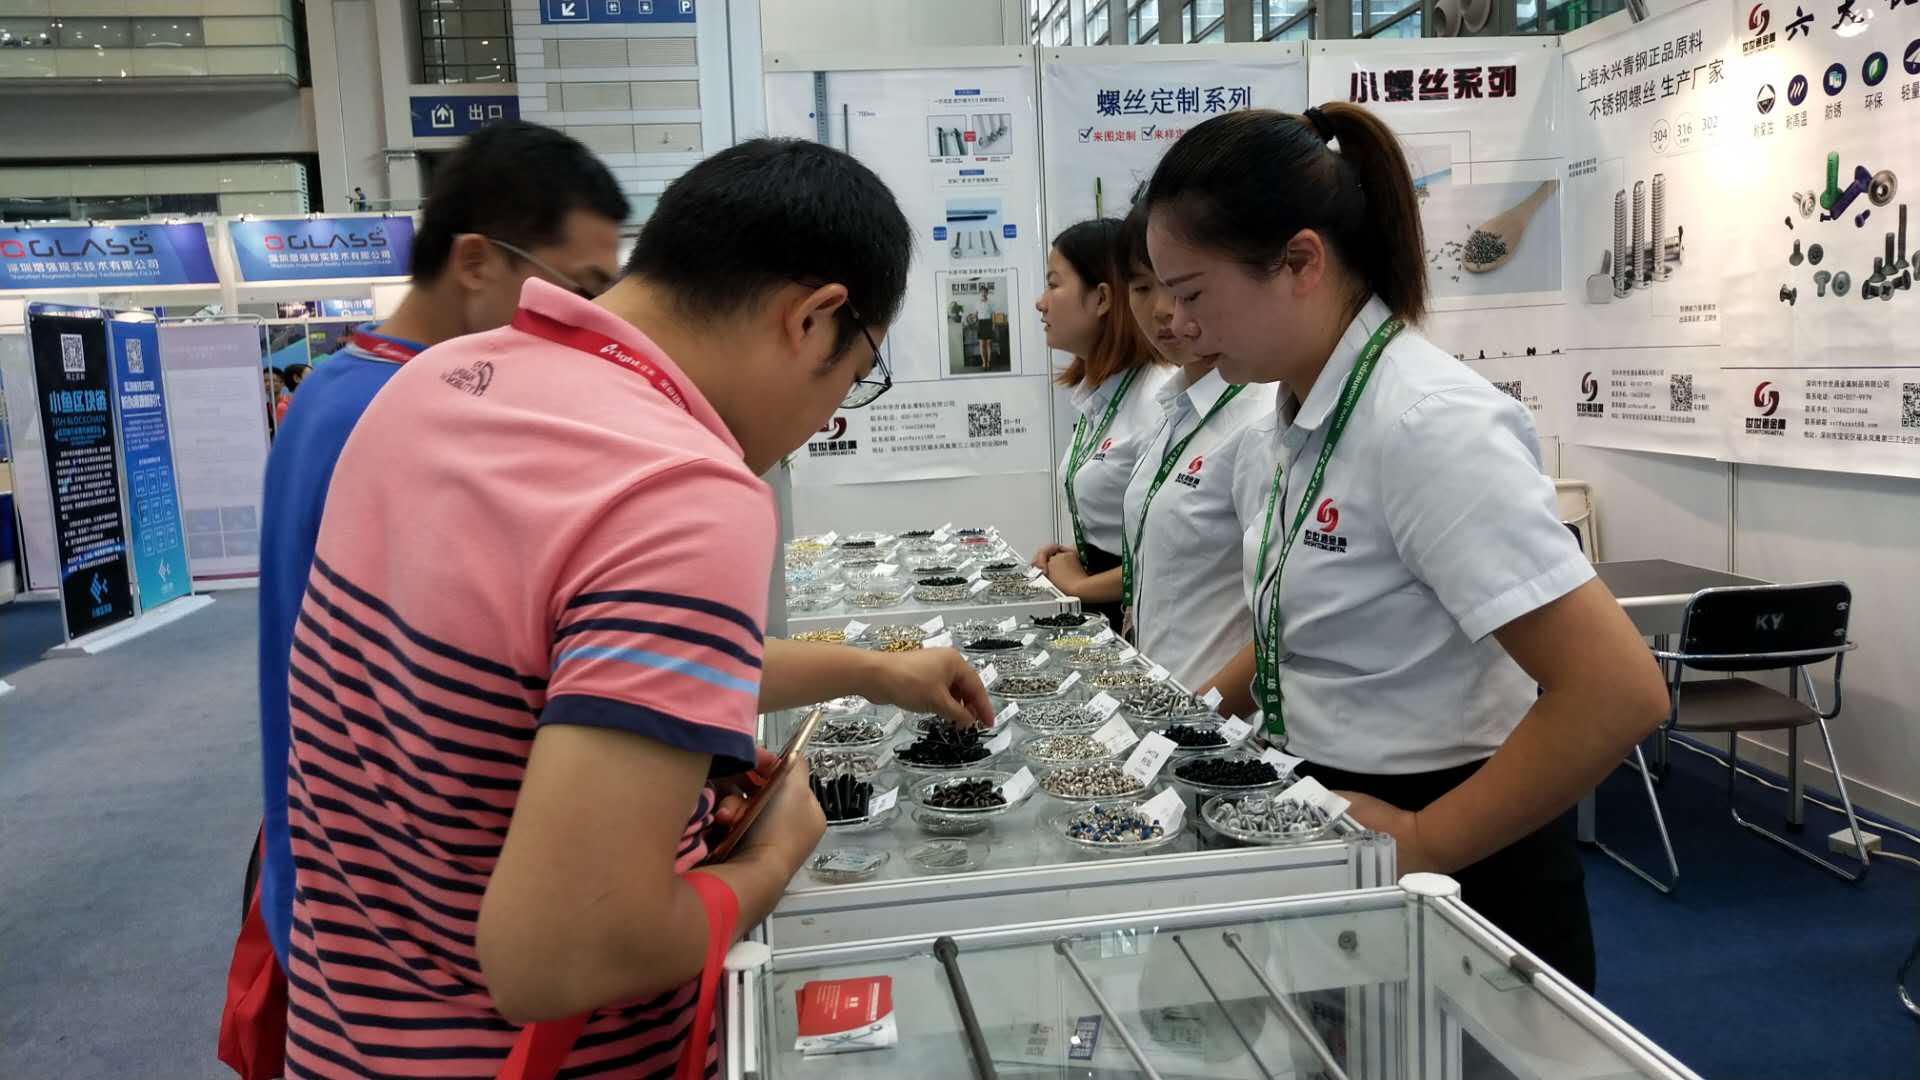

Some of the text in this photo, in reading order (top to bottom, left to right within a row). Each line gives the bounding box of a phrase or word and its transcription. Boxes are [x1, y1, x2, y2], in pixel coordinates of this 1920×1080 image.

[1577, 29, 1703, 92] 上海永兴青钢正品原料
[1350, 65, 1517, 102] 小螺丝系列
[1589, 59, 1724, 120] 不锈钢螺丝 生产厂家
[1096, 86, 1251, 116] 螺丝定制系列
[1865, 92, 1883, 111] 环保
[469, 104, 503, 120] 出口
[1093, 130, 1136, 142] 来图定制
[1653, 129, 1667, 143] 304
[1677, 122, 1692, 137] 316
[1756, 614, 1782, 630] KY
